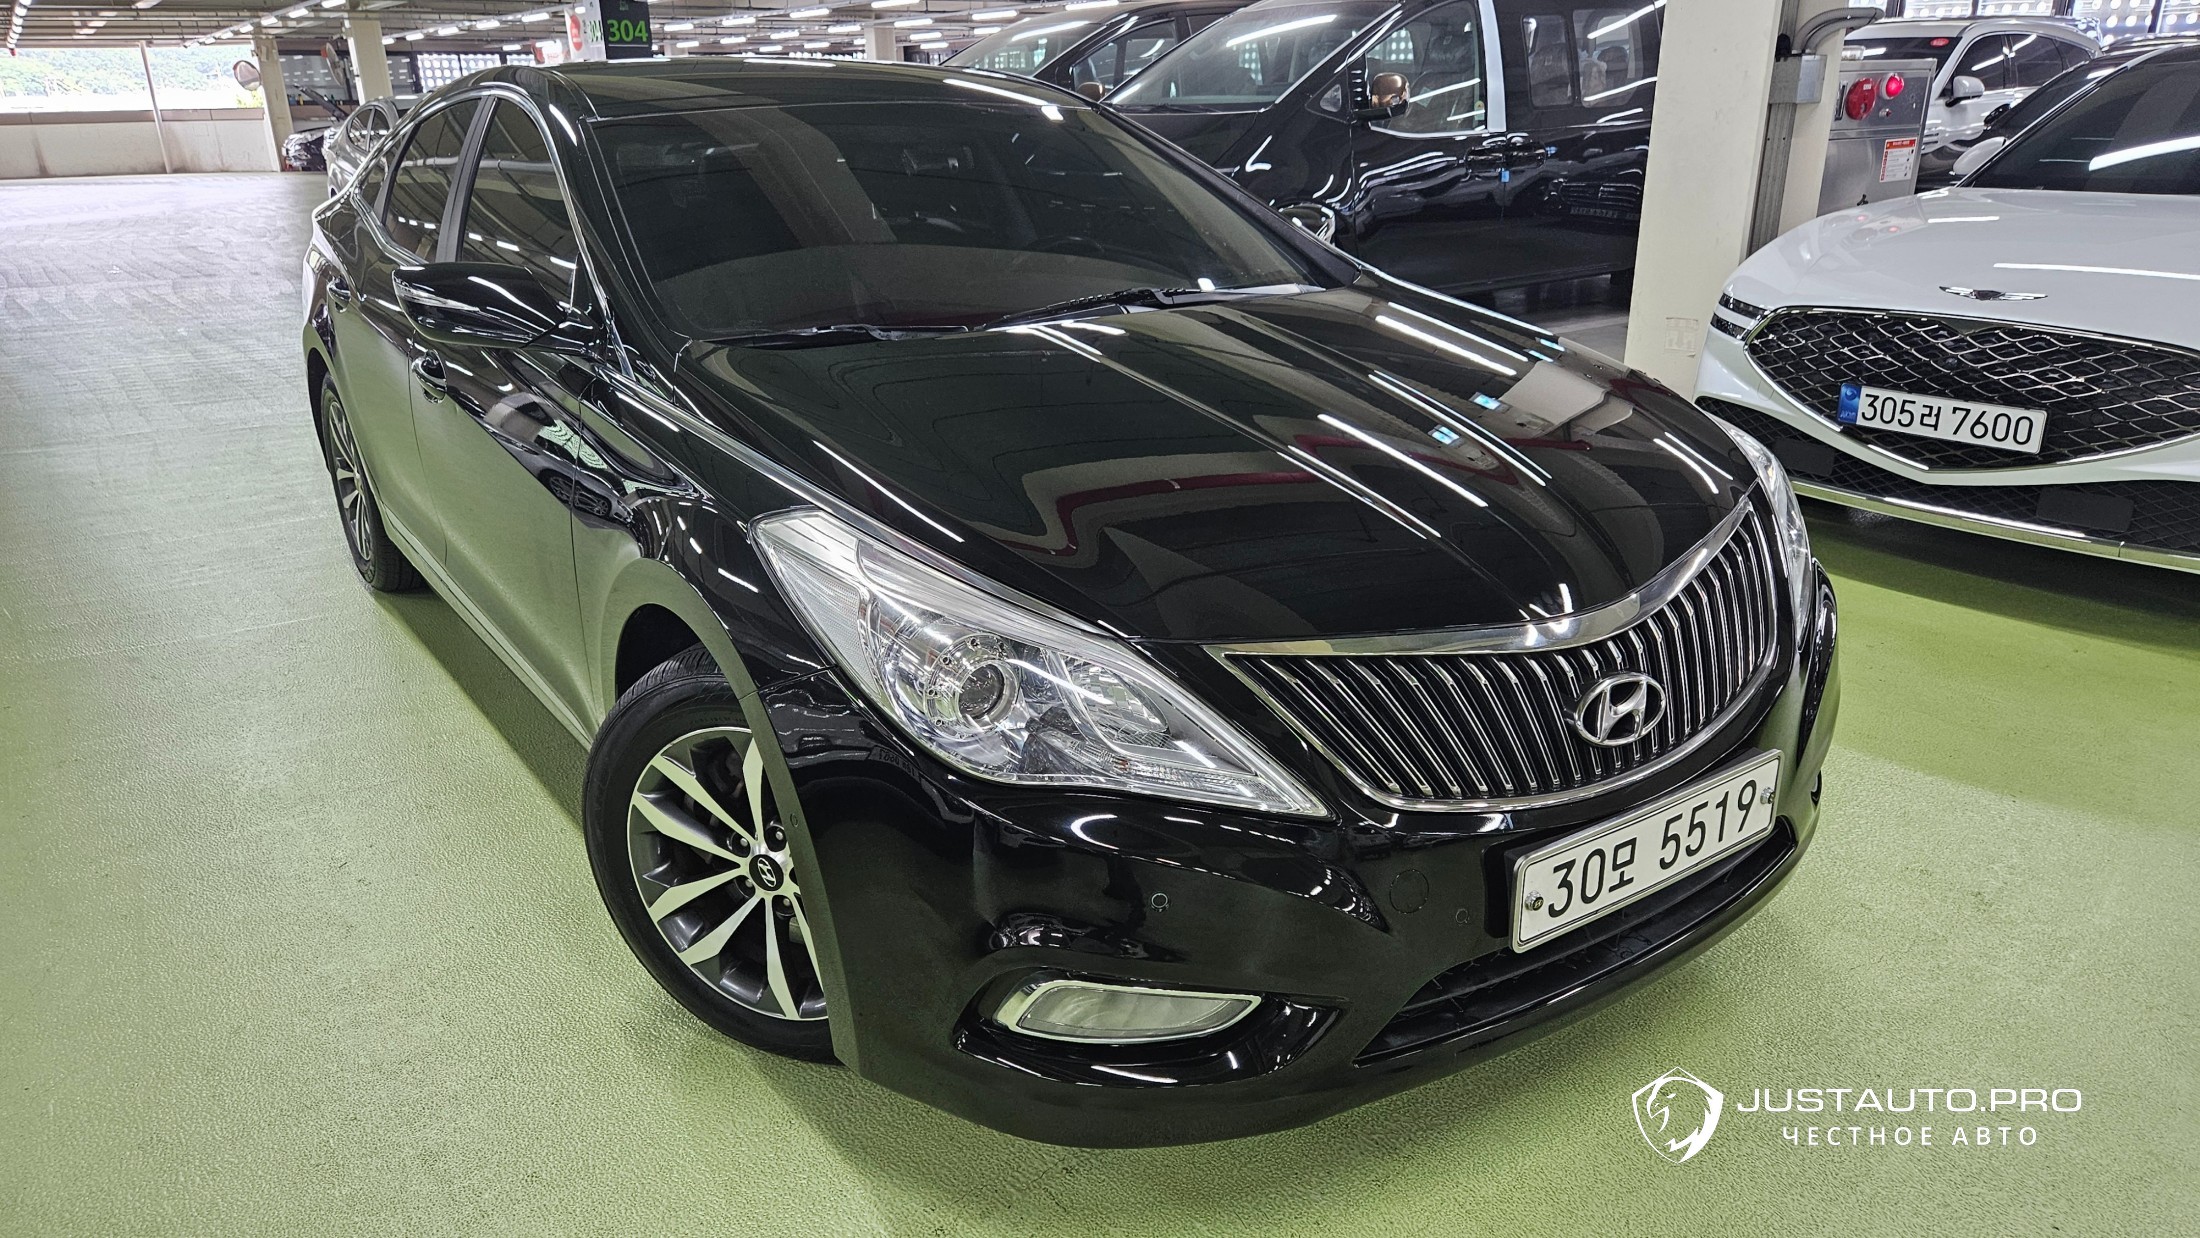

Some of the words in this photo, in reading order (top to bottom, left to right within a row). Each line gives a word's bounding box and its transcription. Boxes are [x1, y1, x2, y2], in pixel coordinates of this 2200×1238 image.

[607, 19, 648, 42] 304
[1861, 394, 1942, 432] 305러
[1951, 407, 2034, 446] 7600
[1548, 837, 1638, 918] 30모
[1659, 779, 1757, 871] 5519
